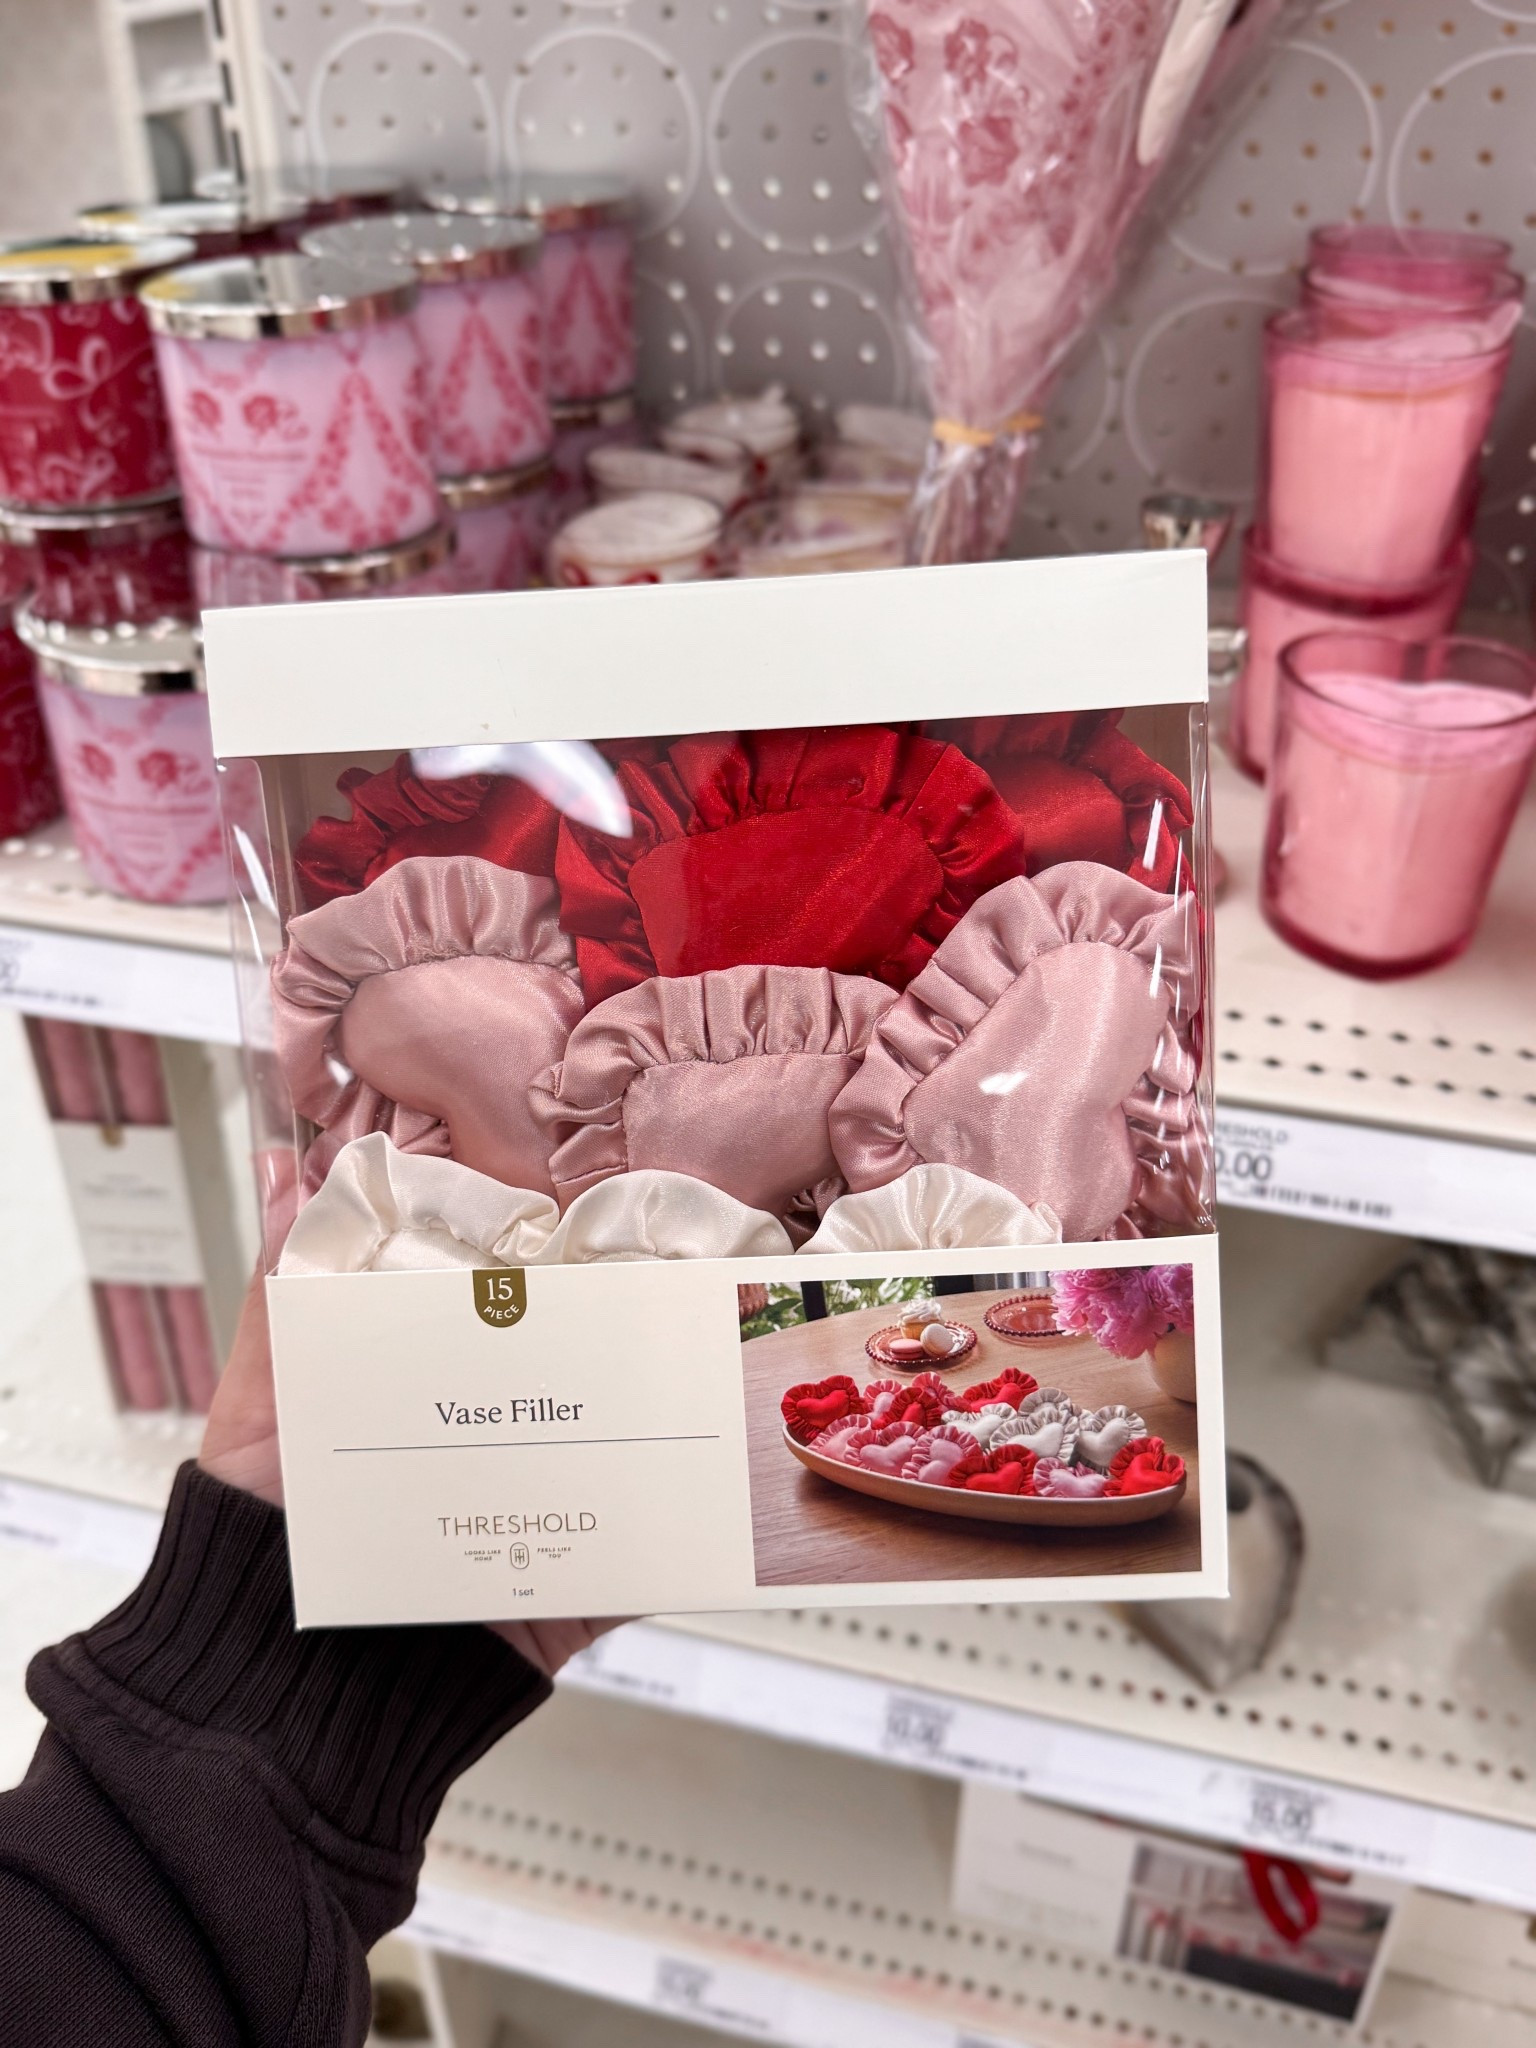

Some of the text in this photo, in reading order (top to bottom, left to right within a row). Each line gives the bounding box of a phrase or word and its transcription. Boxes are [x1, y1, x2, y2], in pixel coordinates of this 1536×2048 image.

[486, 1277, 514, 1300] 15
[483, 1304, 520, 1320] PIECE
[434, 1397, 584, 1425] Vase Filler
[512, 1587, 535, 1596] 1 set
